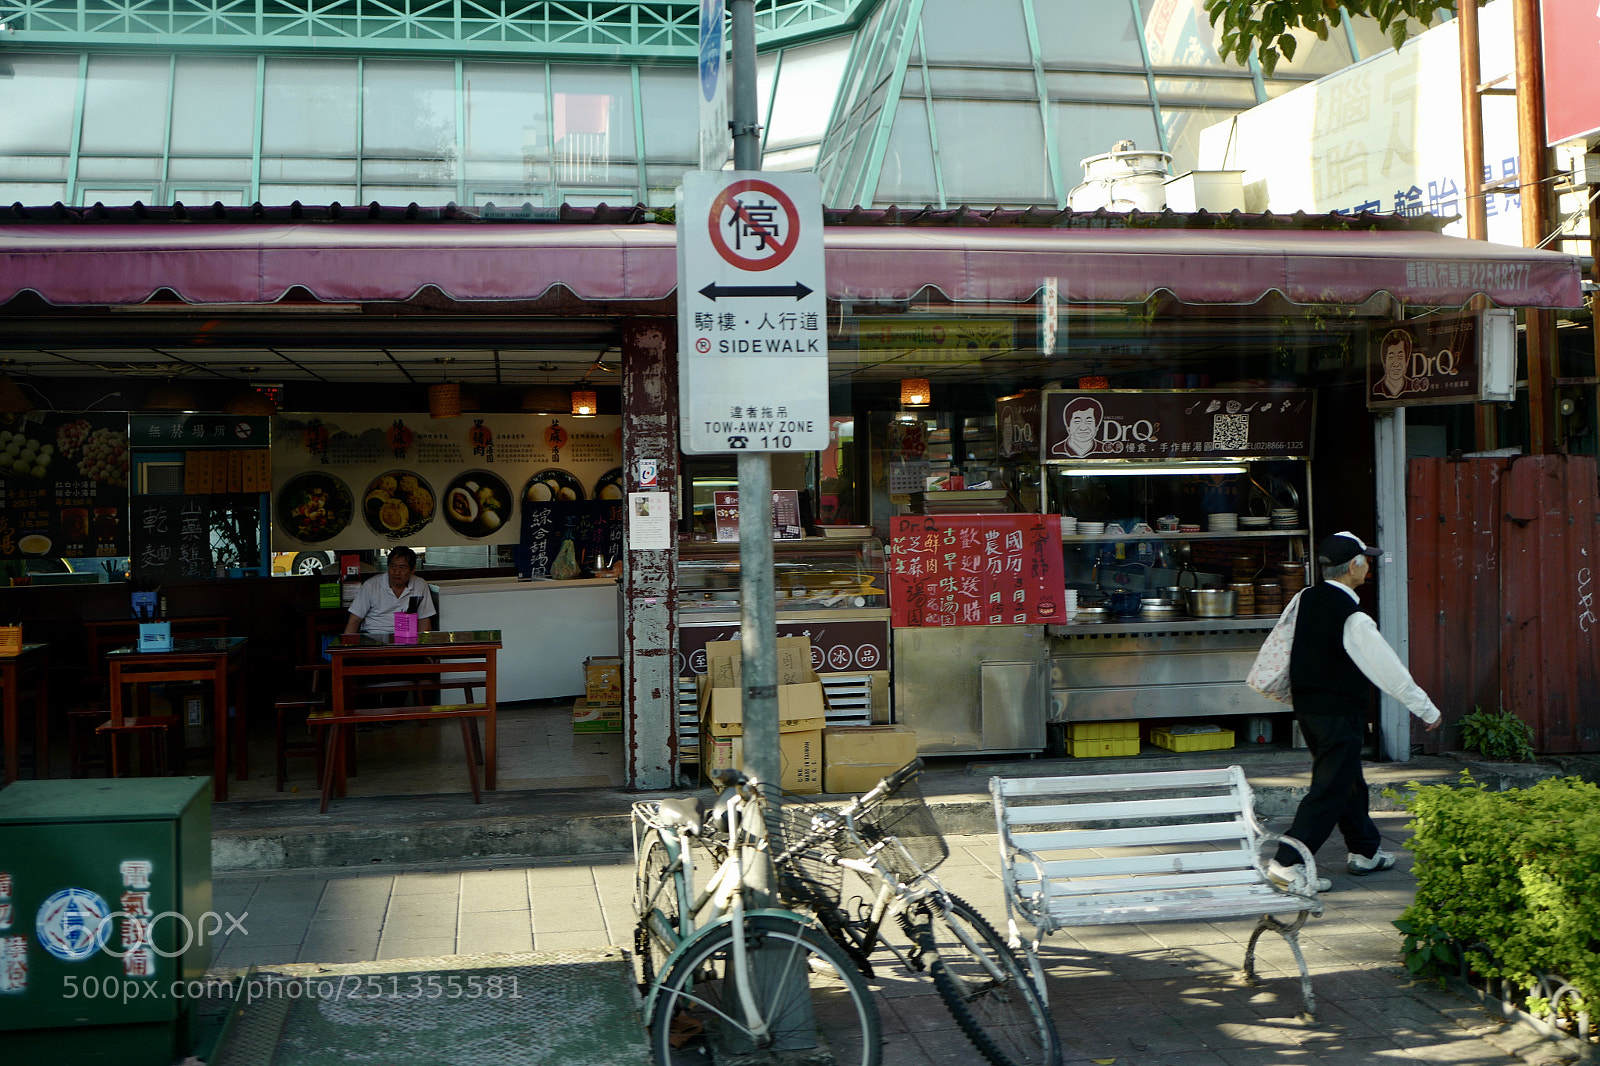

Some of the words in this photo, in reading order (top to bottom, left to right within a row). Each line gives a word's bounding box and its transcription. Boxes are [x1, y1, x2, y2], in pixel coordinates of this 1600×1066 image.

[728, 199, 780, 251] 停
[719, 338, 819, 353] SIDEWALK
[1411, 349, 1456, 378] DrQ
[730, 405, 788, 419] 違者拖吊
[705, 421, 774, 434] TOW-AWAY
[779, 420, 814, 433] ZONE
[1102, 419, 1156, 443] DrQ
[761, 435, 792, 449] 110
[1246, 440, 1304, 451] EL(02)8866-1325
